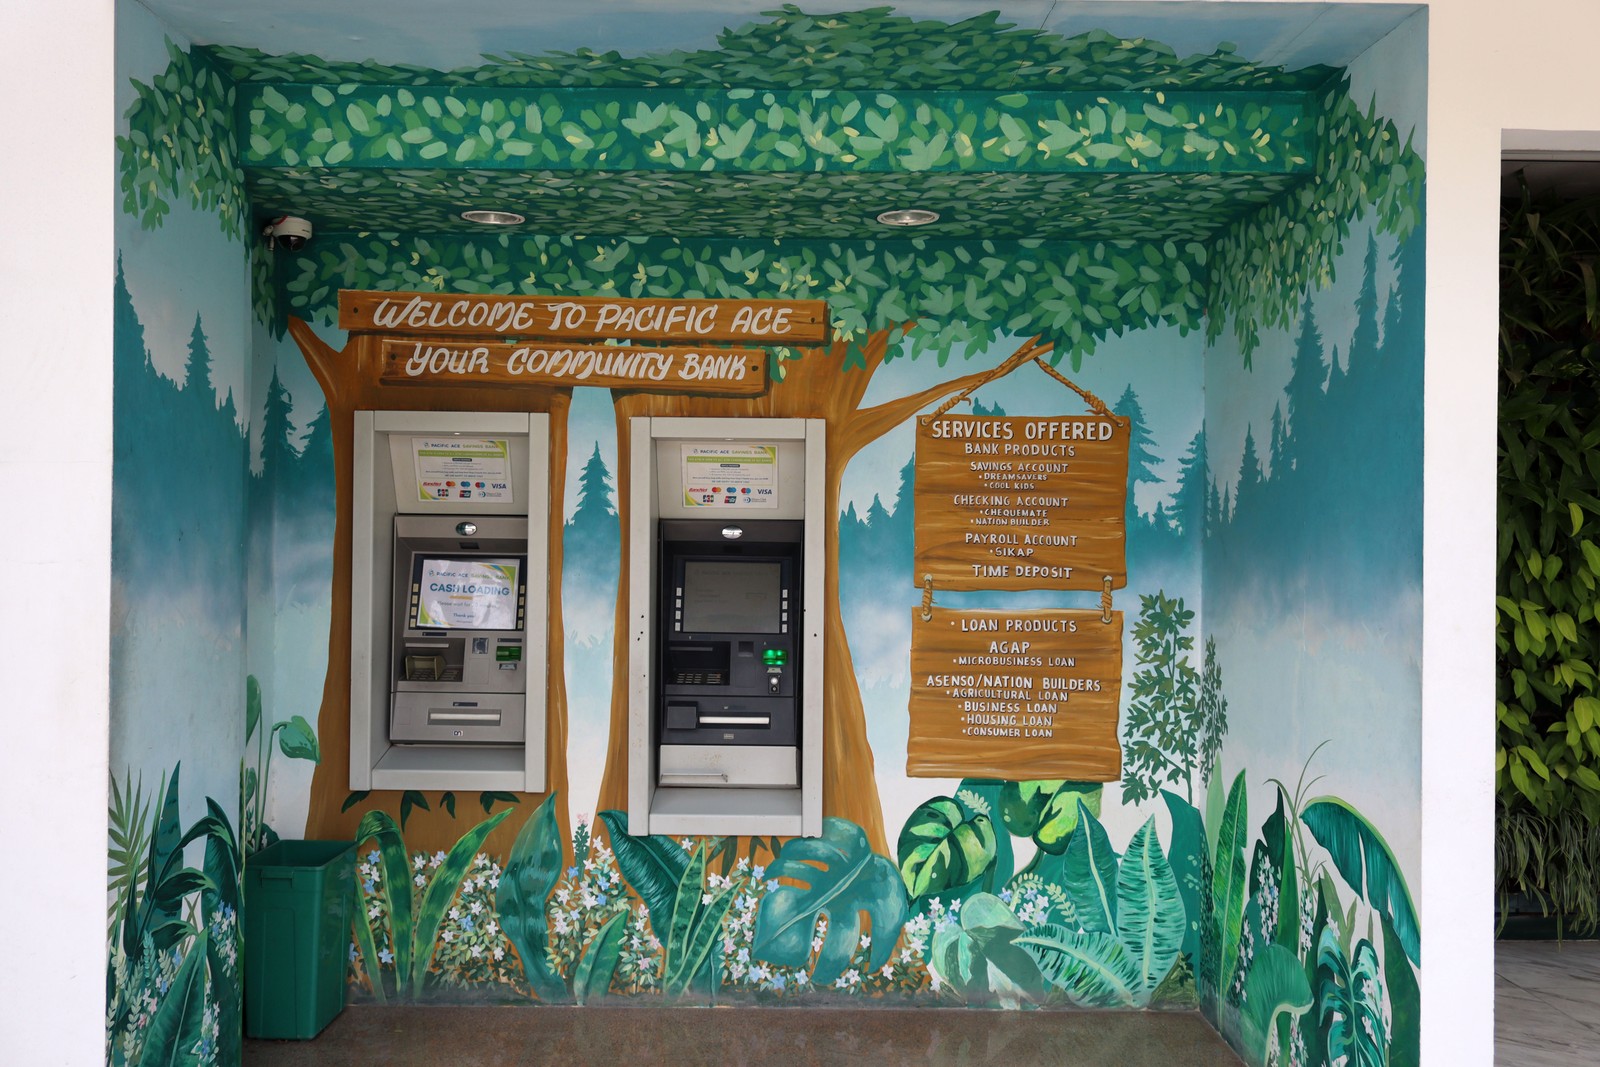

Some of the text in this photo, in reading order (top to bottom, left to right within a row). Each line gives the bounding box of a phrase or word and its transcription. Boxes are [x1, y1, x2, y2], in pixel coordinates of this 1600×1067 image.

[373, 297, 793, 334] WELCOME TO PACIFIC ACE
[405, 342, 747, 380] YOUR COMMUNITY BANK
[931, 420, 1114, 441] SERVICES OFFERED
[965, 443, 1076, 457] BANK PRODUCTS
[970, 461, 1069, 473] SAVINGS ACCOUNT
[984, 473, 1048, 481] DREAMSAVERS
[1014, 482, 1035, 490] KIDS
[953, 494, 1069, 507] CHECKING ACCOUNT
[984, 509, 1048, 518] CHEQUEMATE
[975, 518, 1008, 526] NATION
[965, 533, 1078, 547] PAYROLL ACCOUNT
[995, 548, 1034, 557] SIKAP
[972, 564, 1073, 579] TIME DEPOSIT
[430, 583, 510, 596] CASH LOADING
[961, 619, 1078, 633] LOAN PRODUCTS
[989, 641, 1031, 655] AGAP
[958, 656, 1076, 667] MICROBUSINESS LOAN
[926, 674, 1101, 692] ASENSO/NATION BUILDERS
[952, 689, 1069, 702] AGRICULTURAL LOAN
[964, 702, 1058, 714] BUSINESS LOAN
[967, 714, 1053, 727] HOUSING LOAN
[967, 728, 1053, 738] CONSUMER LOAN
